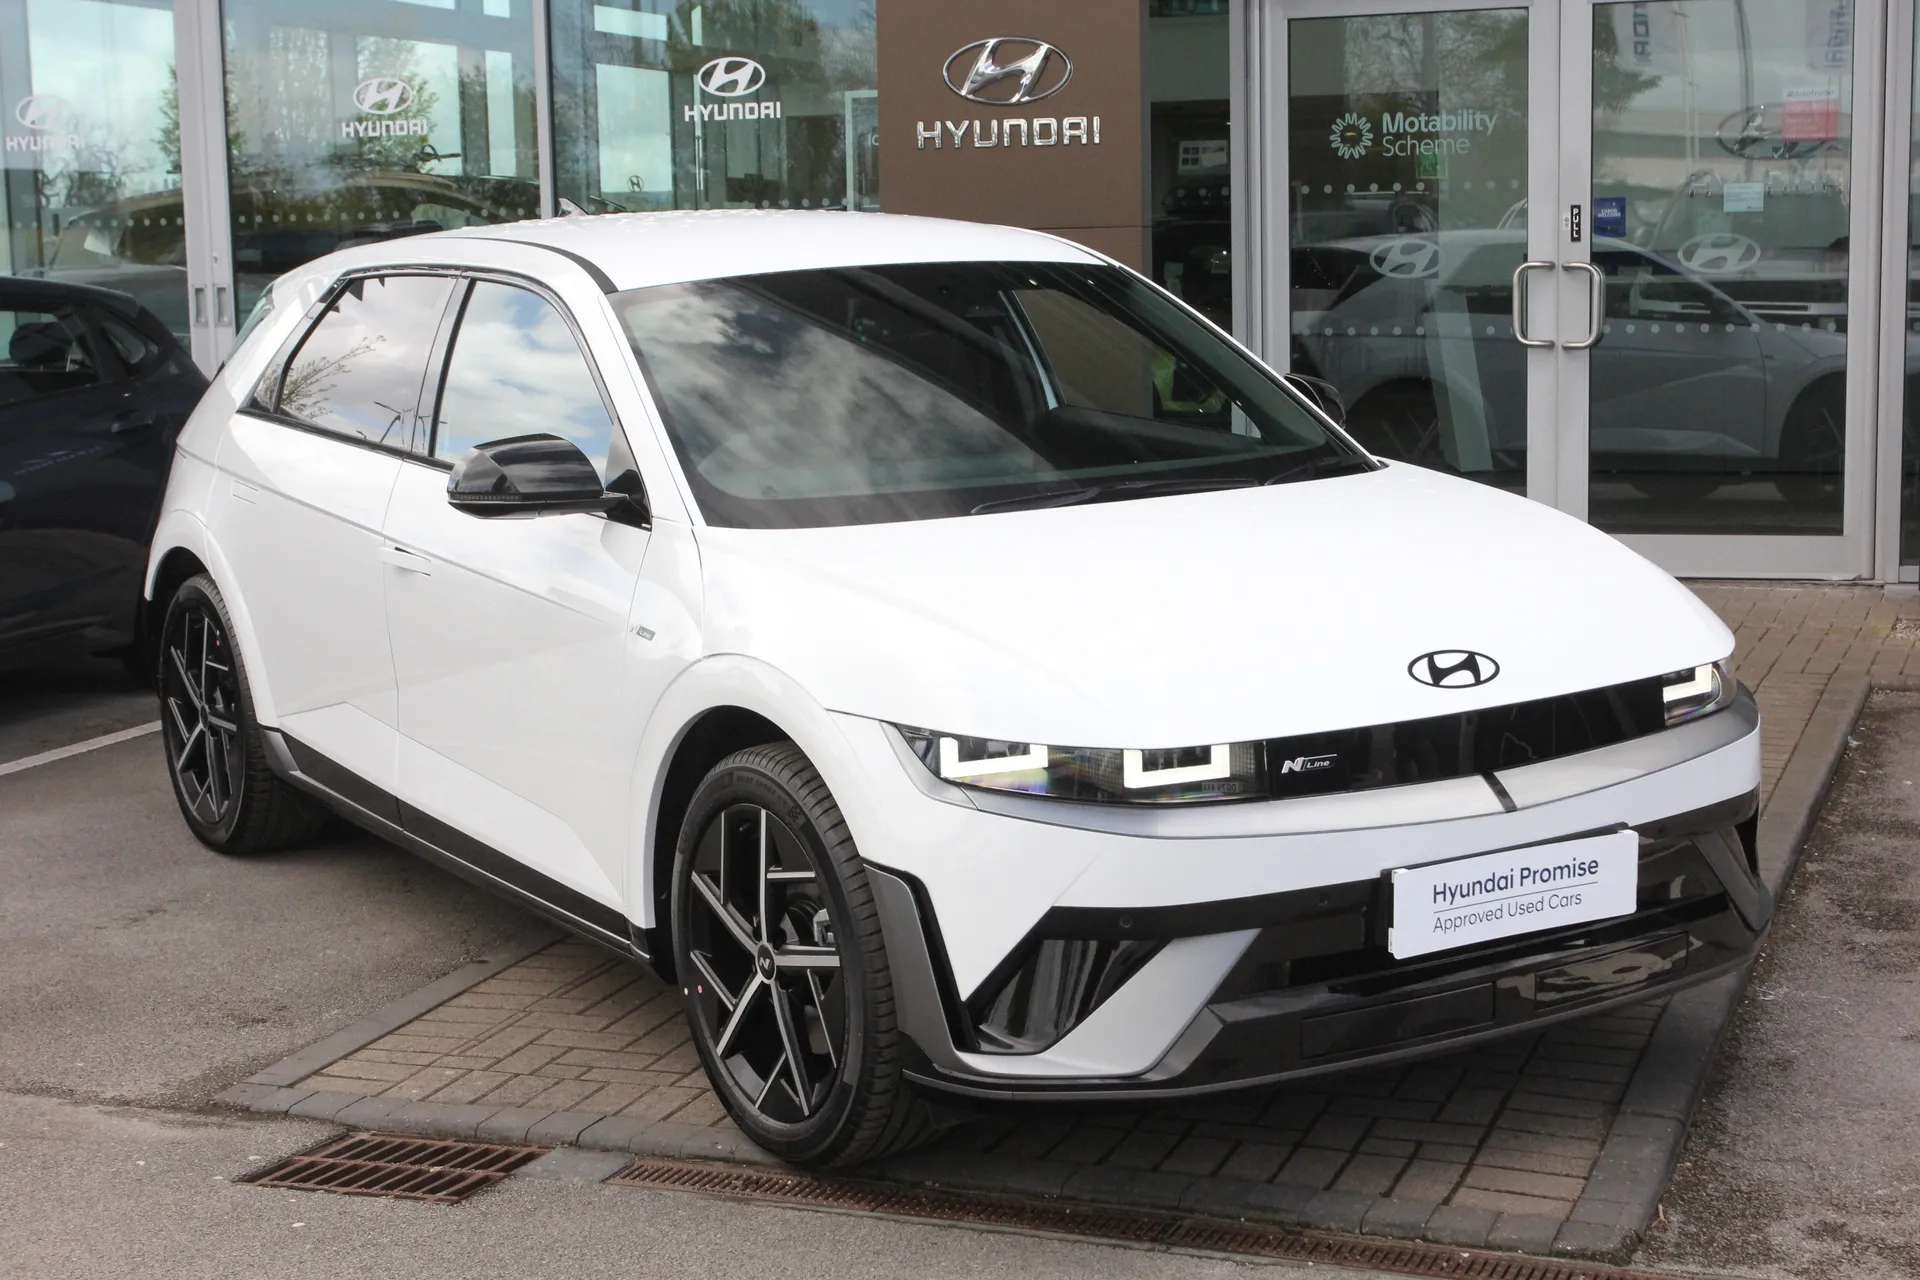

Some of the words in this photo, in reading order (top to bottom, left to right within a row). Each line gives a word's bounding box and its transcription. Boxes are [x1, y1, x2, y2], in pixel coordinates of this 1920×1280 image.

[684, 101, 782, 122] HYUNDAI
[1382, 108, 1498, 136] Motability
[341, 119, 428, 138] HYUNDAI
[916, 115, 1101, 150] HYUNDAI
[6, 135, 85, 152] HYUAI
[1382, 135, 1472, 156] Scheme
[1572, 207, 1580, 238] PULL
[1433, 868, 1514, 905] Hyundai
[1519, 857, 1599, 887] Promise
[1433, 904, 1504, 934] Approved
[1507, 896, 1545, 918] Used
[1548, 892, 1583, 910] Cars
